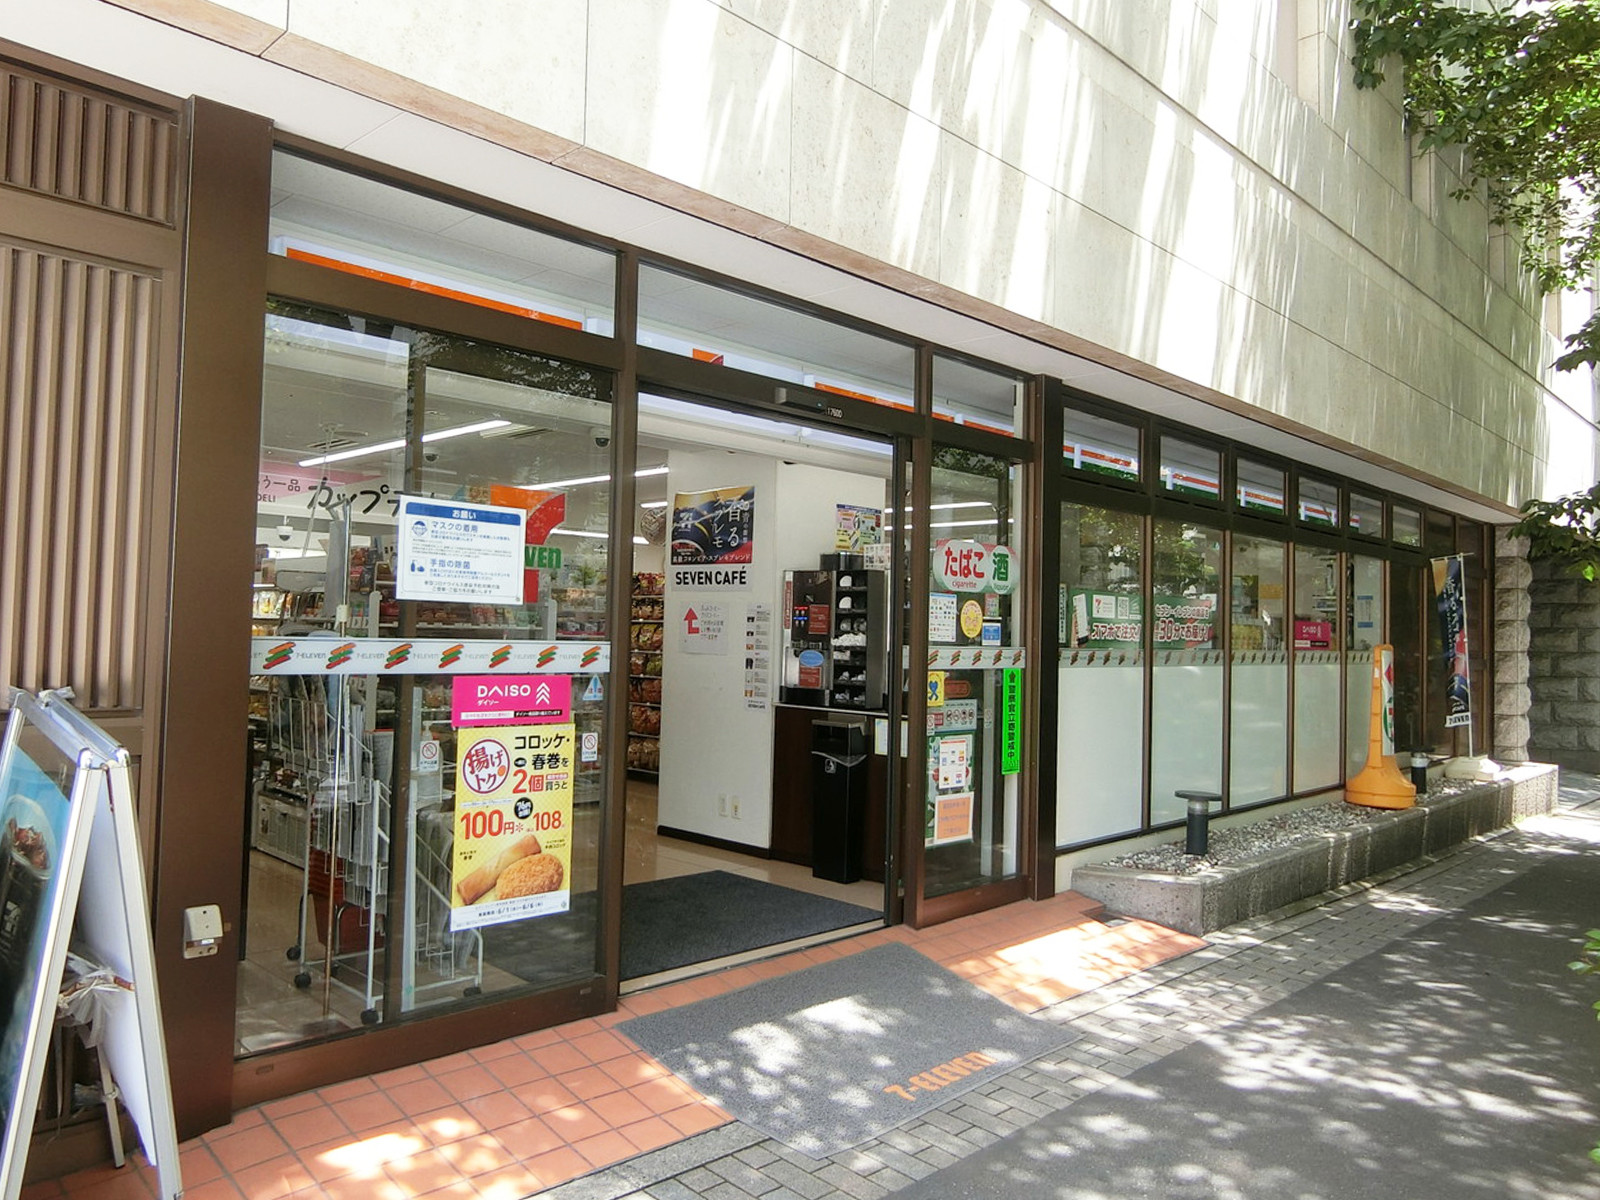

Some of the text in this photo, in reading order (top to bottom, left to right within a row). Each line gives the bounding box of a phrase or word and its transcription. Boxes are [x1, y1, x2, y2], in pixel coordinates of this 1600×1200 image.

[452, 509, 476, 519] お願い
[431, 520, 479, 534] マスクの着用
[429, 558, 472, 571] 手指の除菌
[944, 547, 986, 579] たばこ
[992, 552, 1010, 582] 酒
[675, 565, 748, 586] SEVEN CAFÉ
[477, 684, 532, 698] DAISO
[468, 747, 504, 775] 揚げ
[531, 752, 569, 771] 春巻を
[475, 773, 498, 791] トク
